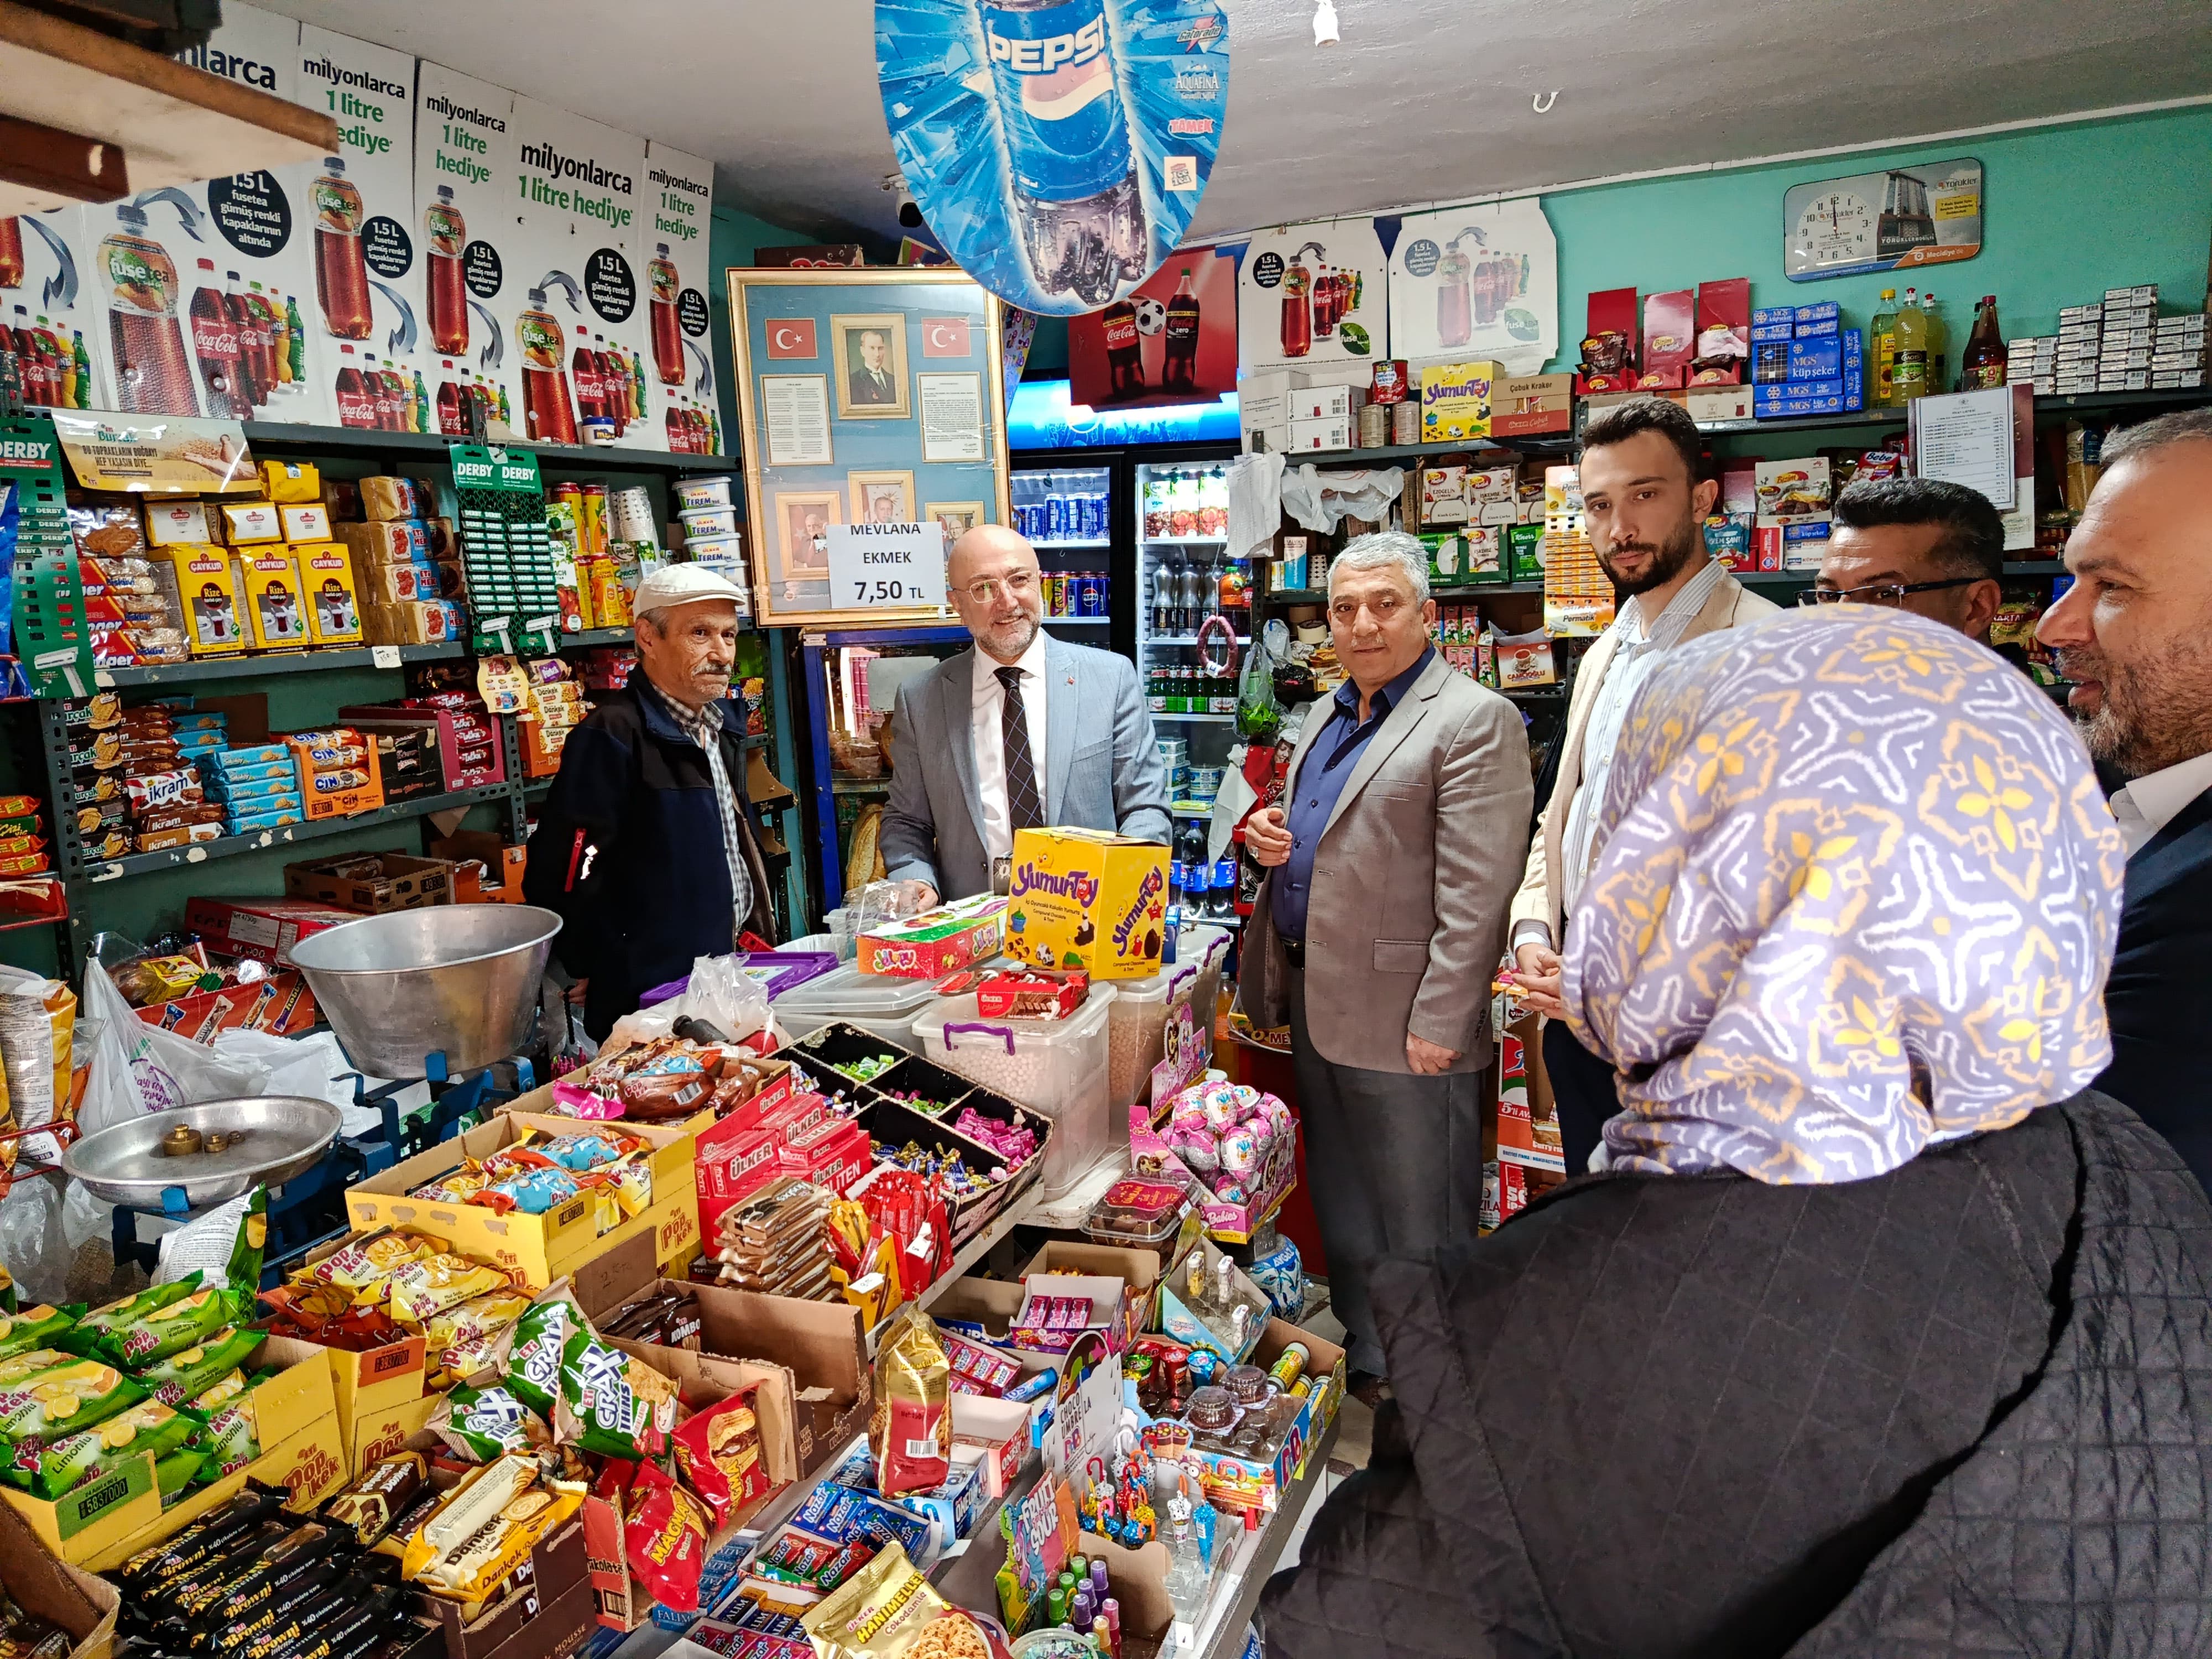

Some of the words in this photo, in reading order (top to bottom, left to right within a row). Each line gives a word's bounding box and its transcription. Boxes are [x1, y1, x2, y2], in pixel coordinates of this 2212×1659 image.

[988, 13, 1105, 72] PEPSI
[303, 58, 405, 100] milyonlarca
[1176, 72, 1219, 90] AQUAFINA
[326, 90, 335, 111] 1
[341, 91, 384, 123] litre
[426, 95, 506, 133] milyonlarca
[1170, 119, 1213, 133] TAMEK
[337, 125, 390, 154] ediye
[442, 125, 450, 144] 1
[453, 126, 487, 154] litre
[436, 148, 490, 182] hediye
[521, 141, 633, 195] milyonlarca
[259, 174, 270, 194] L
[649, 168, 709, 197] milyonlarca
[232, 190, 268, 207] fusetea
[519, 174, 526, 198] 1
[531, 176, 569, 210] litre
[573, 190, 631, 228] hediye
[661, 192, 666, 208] 1
[669, 194, 695, 216] litre
[221, 202, 253, 220] gümüş
[254, 207, 281, 223] renkli
[222, 216, 282, 237] kapaklarının
[372, 222, 390, 235] 1.5
[391, 225, 400, 237] L
[655, 213, 697, 241] hediye
[238, 232, 272, 249] altında
[374, 236, 398, 247] fusetea
[597, 254, 614, 270] 1.5
[615, 258, 623, 274] L
[599, 272, 621, 284] fusetea
[1793, 358, 1816, 366] MGS
[1792, 368, 1811, 378] küp
[1510, 384, 1529, 393] Çubuk
[1787, 387, 1809, 395] MGS
[1789, 401, 1809, 410] MGS
[457, 462, 493, 477] DERBY
[502, 466, 535, 481] DERBY
[686, 497, 711, 505] TEREM
[692, 525, 717, 534] TEREM
[851, 524, 921, 535] MEVLANA
[190, 561, 223, 571] ÇAYKUR
[255, 560, 287, 570] ÇAYKUR
[312, 559, 344, 568] ÇAYKUR
[863, 551, 911, 564] EKMEK
[204, 587, 221, 598] Rize
[269, 586, 284, 596] Rize
[325, 583, 341, 593] Rize
[854, 581, 902, 604] 7,50
[909, 587, 925, 599] TL
[1563, 614, 1596, 623] Permatik
[537, 685, 557, 696] Dankek
[544, 705, 565, 713] Dankek
[149, 778, 187, 802] ikram
[148, 837, 176, 851] ikram
[760, 1087, 786, 1113] ÜLKER
[786, 1108, 821, 1141] ÜLKER
[790, 1120, 841, 1146] ÜLKER
[731, 1142, 773, 1180] ÜLKER
[812, 1158, 843, 1185] ÜLKER
[1207, 1209, 1238, 1224] Babies
[351, 1263, 371, 1280] Muzlu
[402, 1269, 424, 1289] Muzlu
[517, 1339, 539, 1360] ETi
[954, 1348, 972, 1372] Nazar
[973, 1355, 990, 1380] Nazar
[993, 1364, 1011, 1387] Nazar
[582, 1389, 594, 1408] ETi
[1060, 1392, 1080, 1424] CHOCO
[53, 1434, 92, 1474] Limonlu
[804, 1486, 829, 1523] Nazar
[827, 1498, 852, 1533] Nazar
[650, 1504, 690, 1566] MAGMA
[1030, 1502, 1058, 1556] SOUR
[445, 1514, 504, 1567] Dankek
[768, 1539, 790, 1566] Nazar
[794, 1548, 816, 1577] Nazar
[482, 1550, 523, 1589] Dankek
[821, 1550, 852, 1586] Nazar
[658, 1610, 691, 1623] FALIM
[723, 1598, 749, 1622] FALIM
[847, 1606, 875, 1632] ÜLKER
[884, 1591, 927, 1636] Çokodamla
[555, 1623, 586, 1654] MOUSSE
